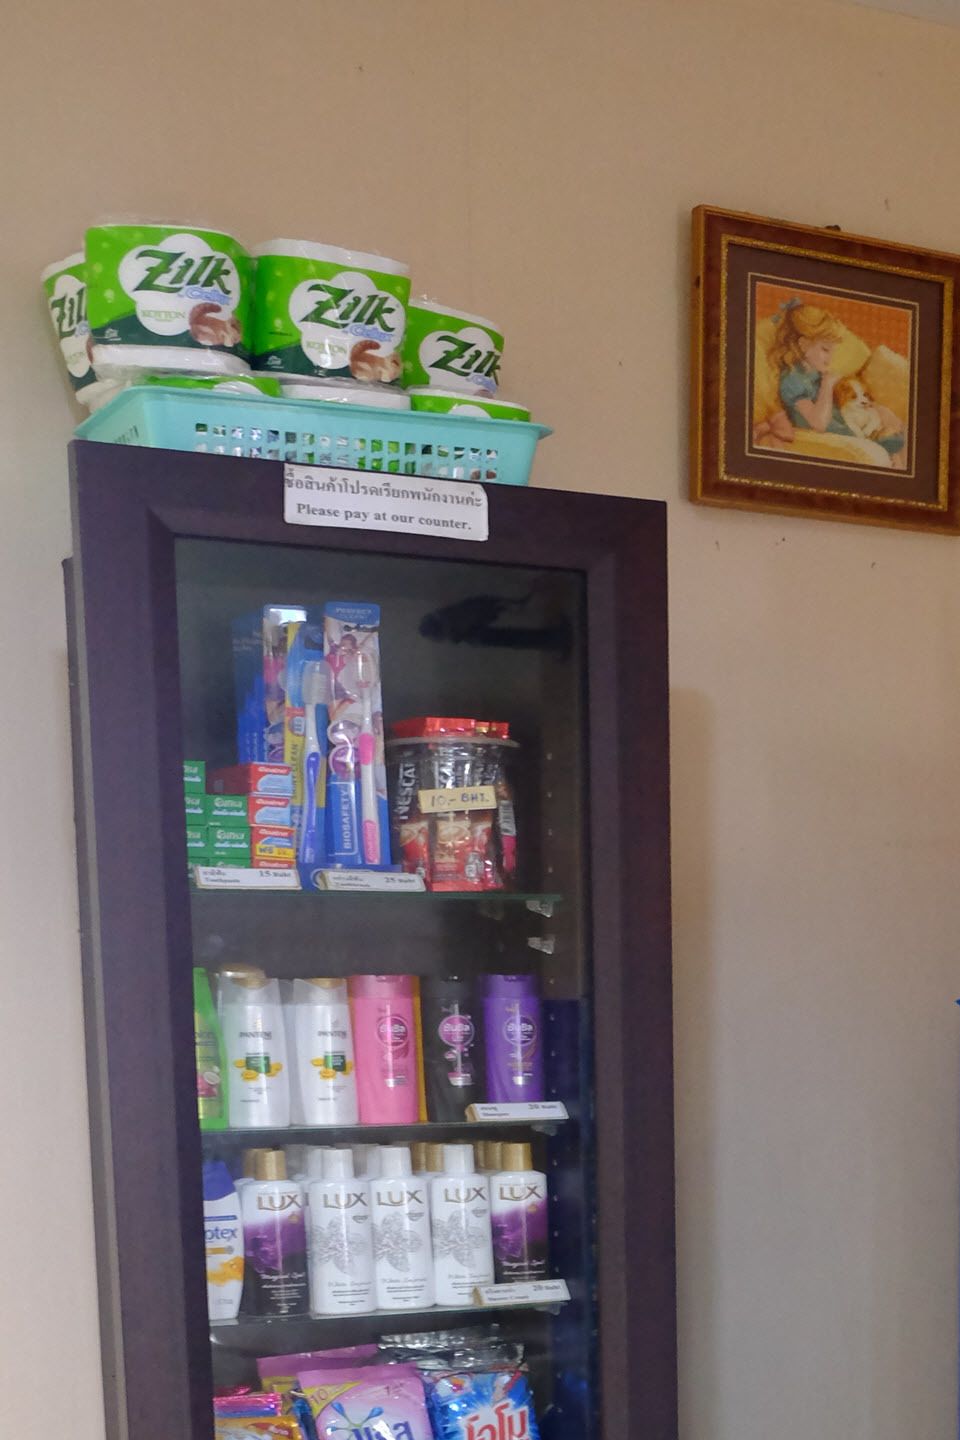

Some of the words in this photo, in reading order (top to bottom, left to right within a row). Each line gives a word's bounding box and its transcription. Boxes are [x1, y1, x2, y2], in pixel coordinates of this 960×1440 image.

[133, 249, 232, 294] Zilk
[51, 288, 87, 338] Zil
[302, 283, 396, 332] Zilk
[297, 503, 339, 518] Please
[344, 510, 369, 522] pay
[374, 509, 387, 521] at
[392, 514, 414, 525] our
[418, 515, 471, 530] counter.
[342, 787, 350, 850] BIOSAFETY
[257, 1194, 302, 1211] LUX
[323, 1192, 368, 1209] LUX
[376, 1189, 423, 1206] LUX
[444, 1186, 486, 1203] LUX
[500, 1184, 542, 1201] LUX
